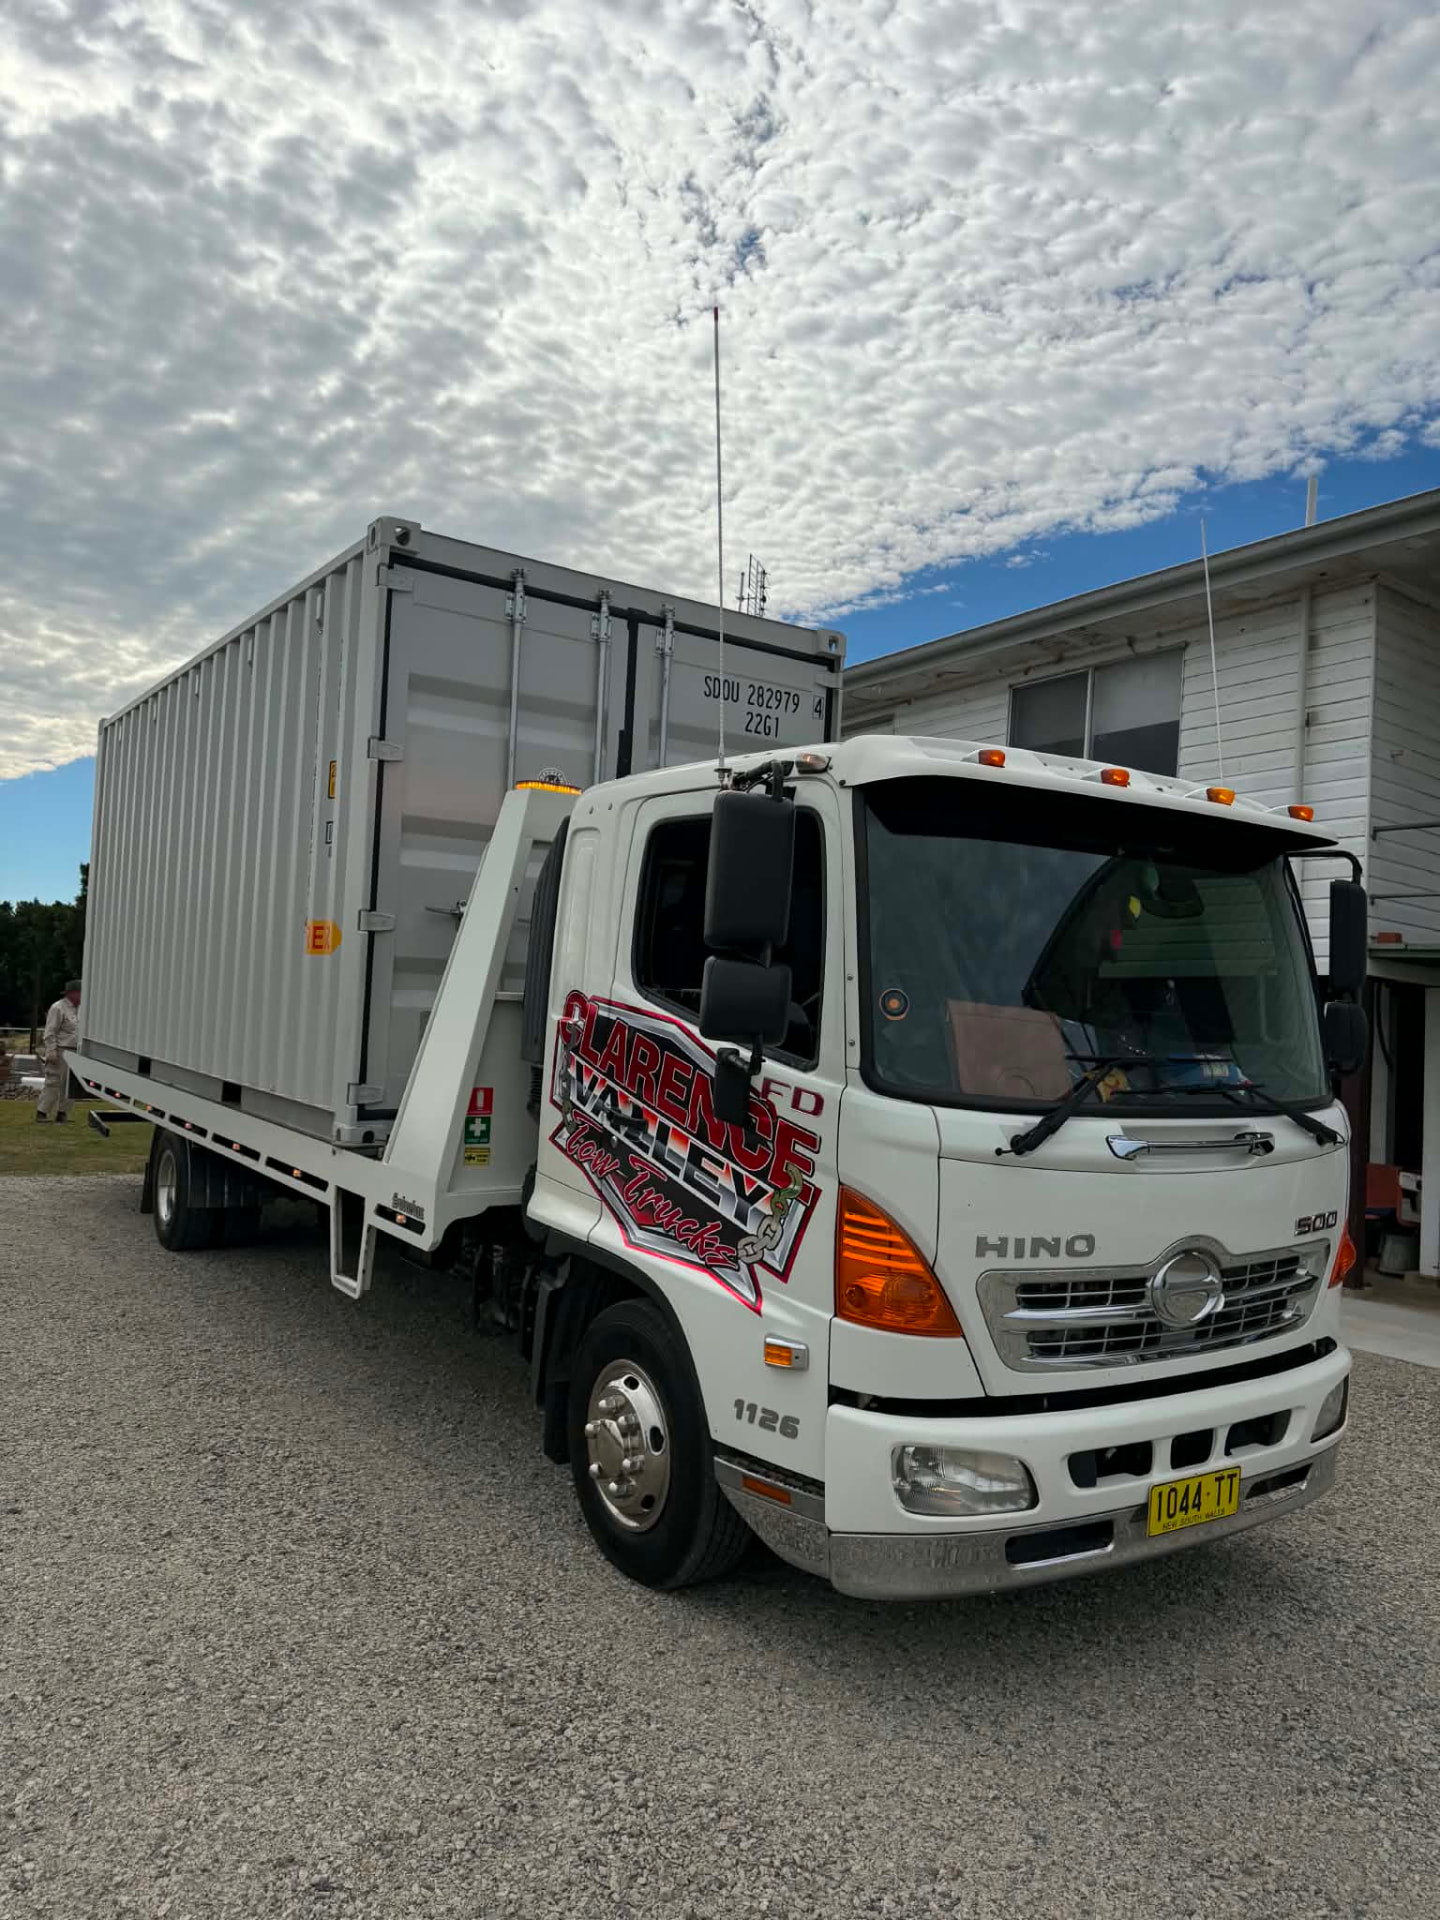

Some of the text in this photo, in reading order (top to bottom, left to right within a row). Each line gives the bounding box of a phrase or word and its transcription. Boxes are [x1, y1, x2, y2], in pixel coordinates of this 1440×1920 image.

[703, 675, 823, 720] SDOU 282979 4
[744, 711, 779, 738] 22G1
[560, 990, 821, 1206] CLARENCE
[761, 1077, 825, 1117] FD
[573, 1057, 770, 1227] VALLEY
[566, 1109, 739, 1270] Tow Trucks
[1294, 1210, 1338, 1237] 500
[975, 1233, 1096, 1259] HINO
[733, 1398, 801, 1440] 1126
